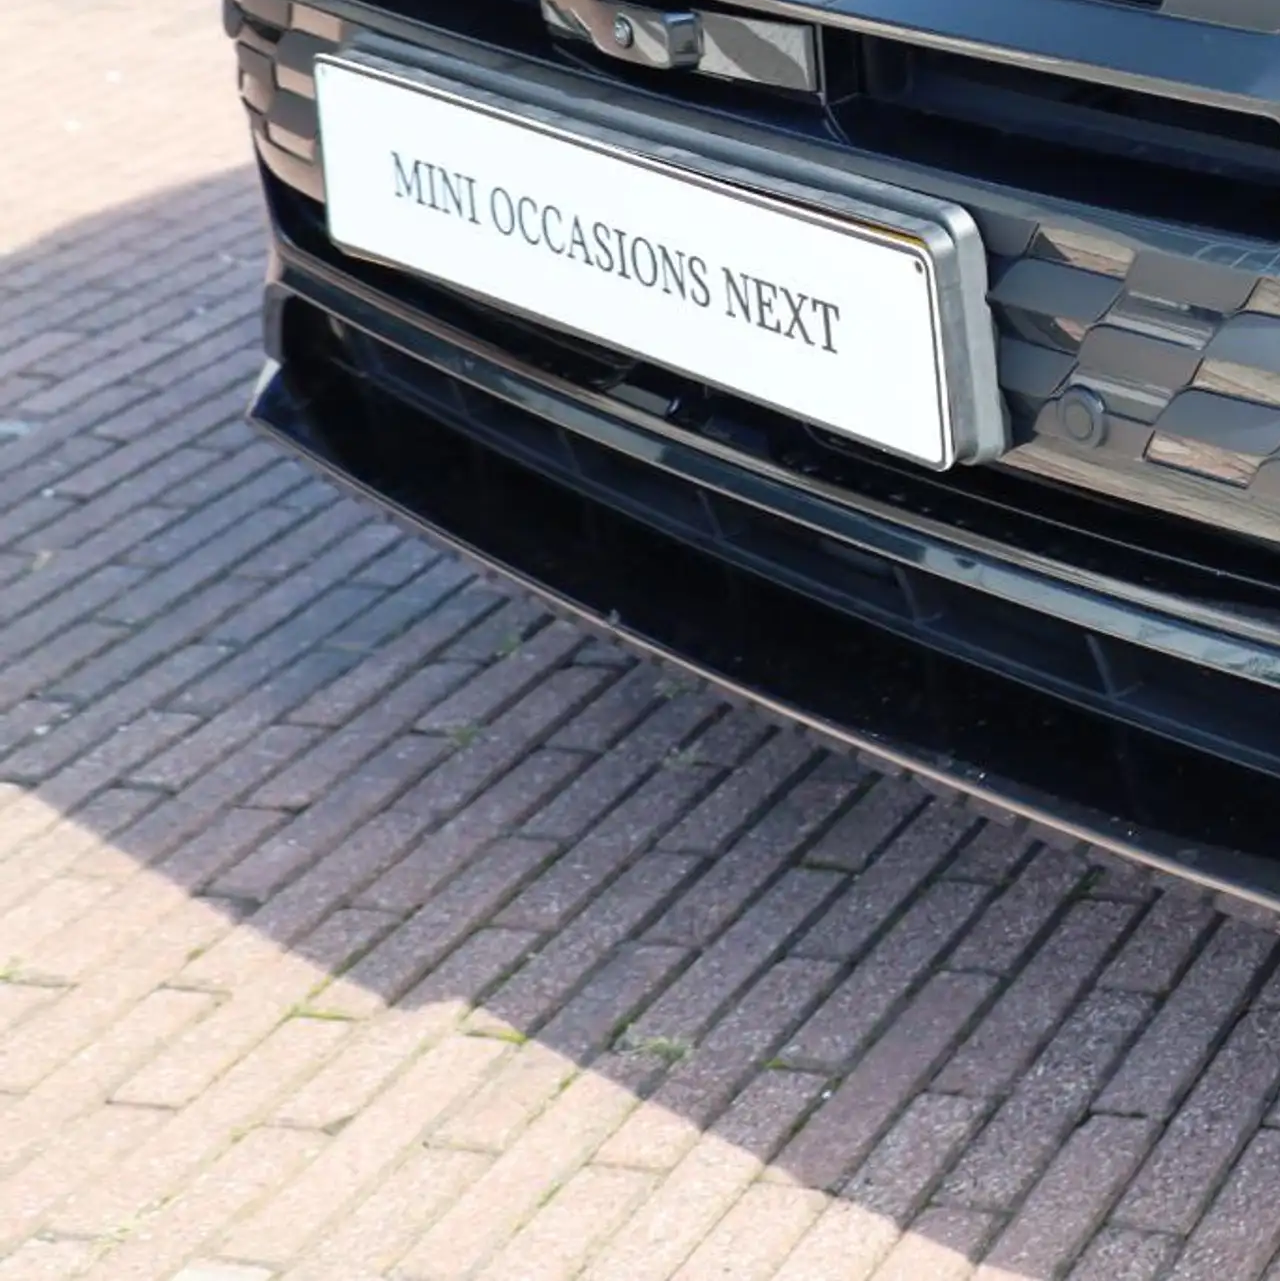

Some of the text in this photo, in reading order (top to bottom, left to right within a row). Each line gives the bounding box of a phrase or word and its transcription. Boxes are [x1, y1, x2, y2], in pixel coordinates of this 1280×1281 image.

[390, 150, 840, 355] MINI OCCASIONS NEXT
